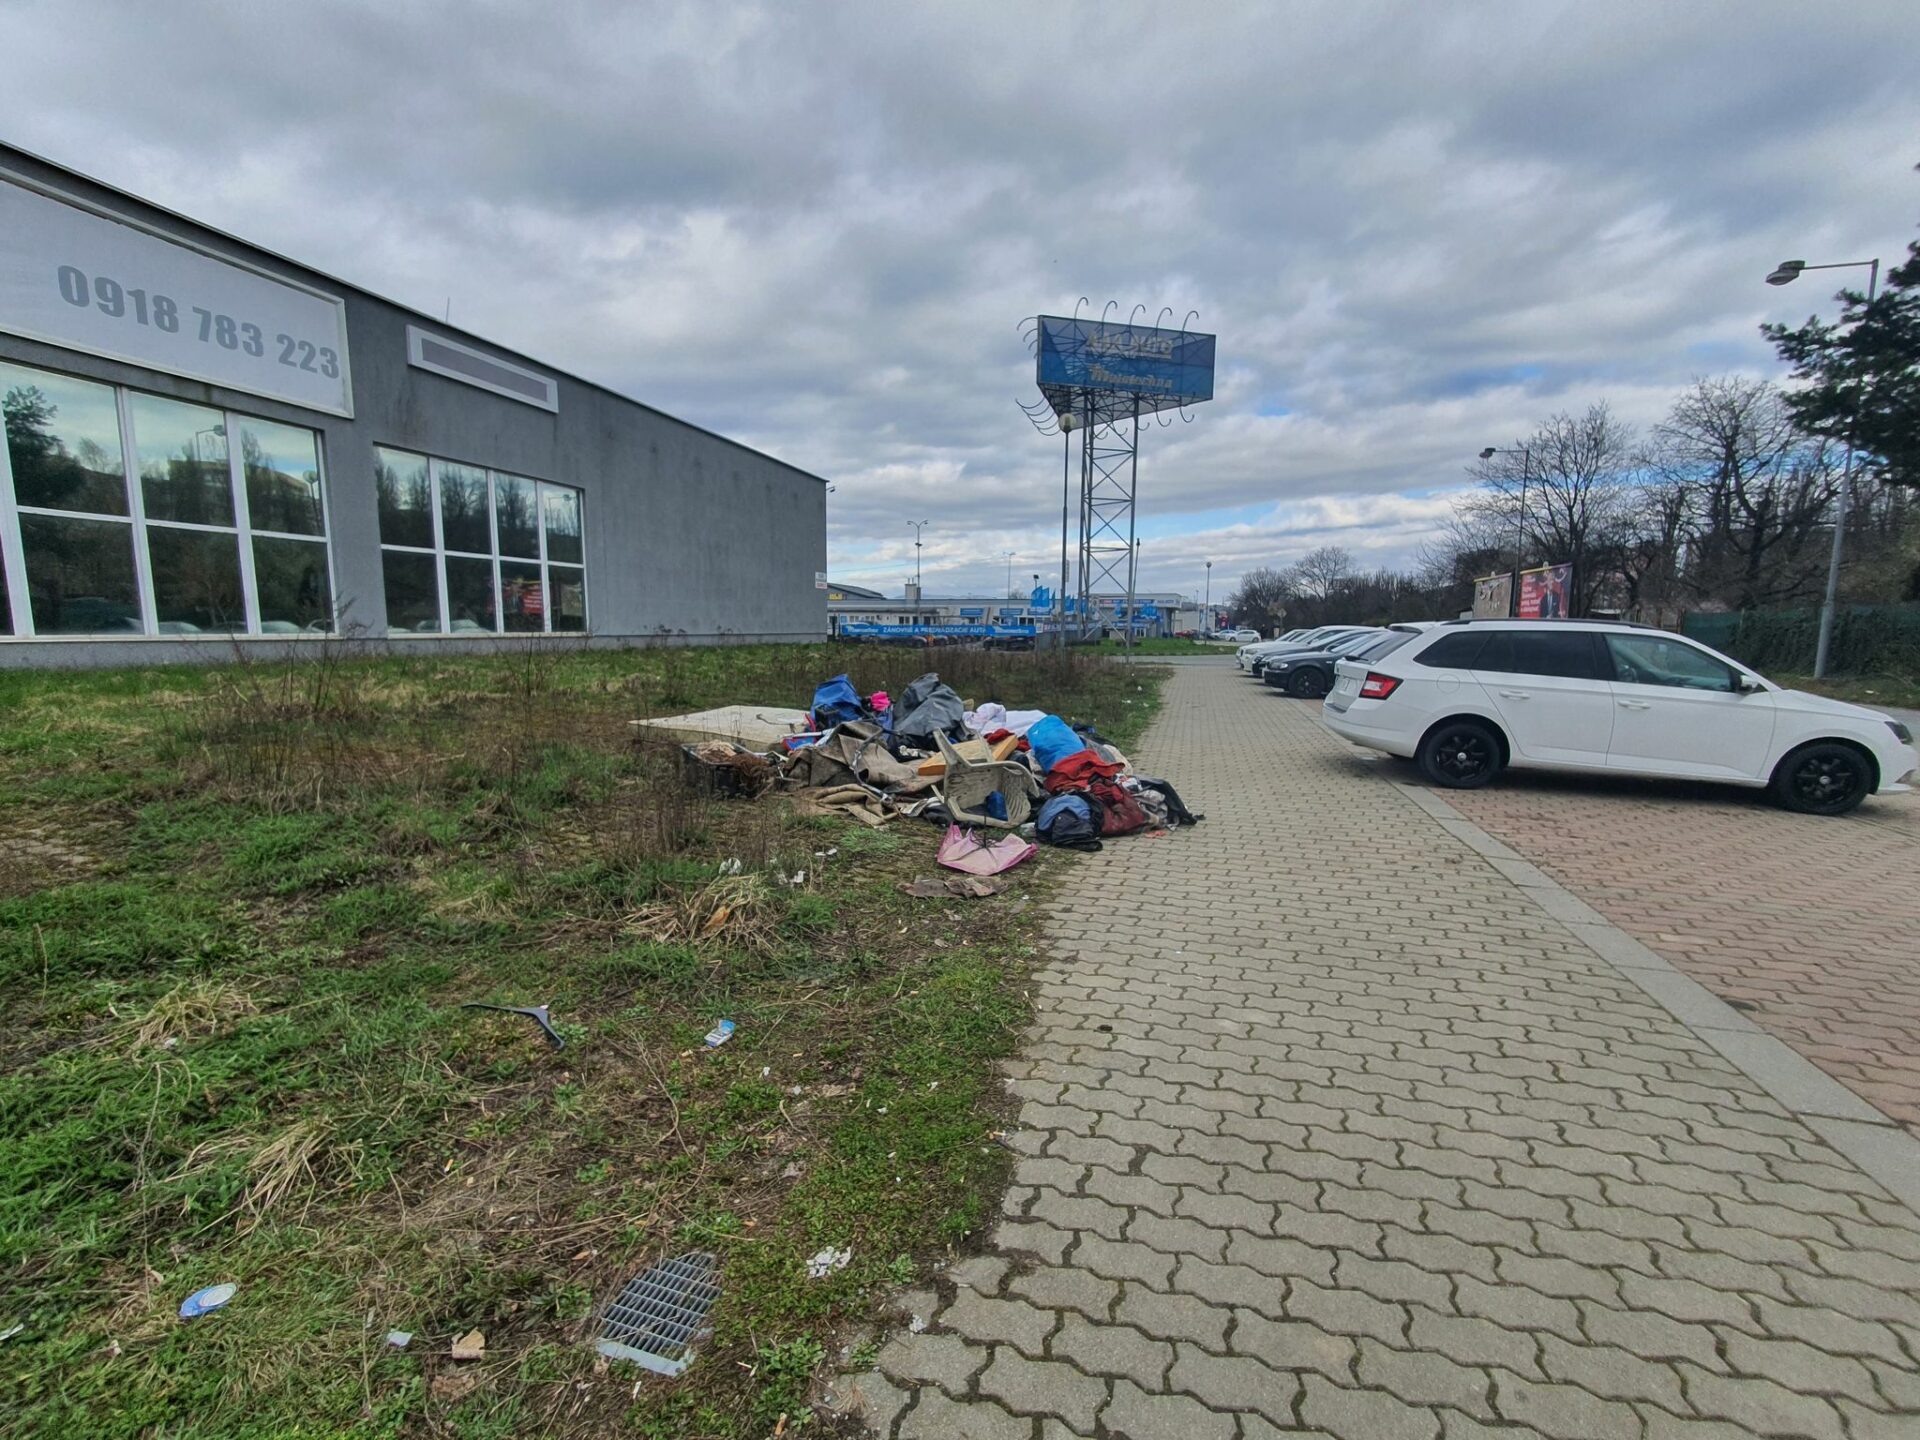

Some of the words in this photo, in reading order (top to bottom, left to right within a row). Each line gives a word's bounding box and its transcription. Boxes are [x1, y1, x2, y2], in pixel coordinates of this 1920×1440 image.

[57, 265, 180, 334] 0918
[192, 306, 265, 358] 783
[276, 333, 340, 379] 223
